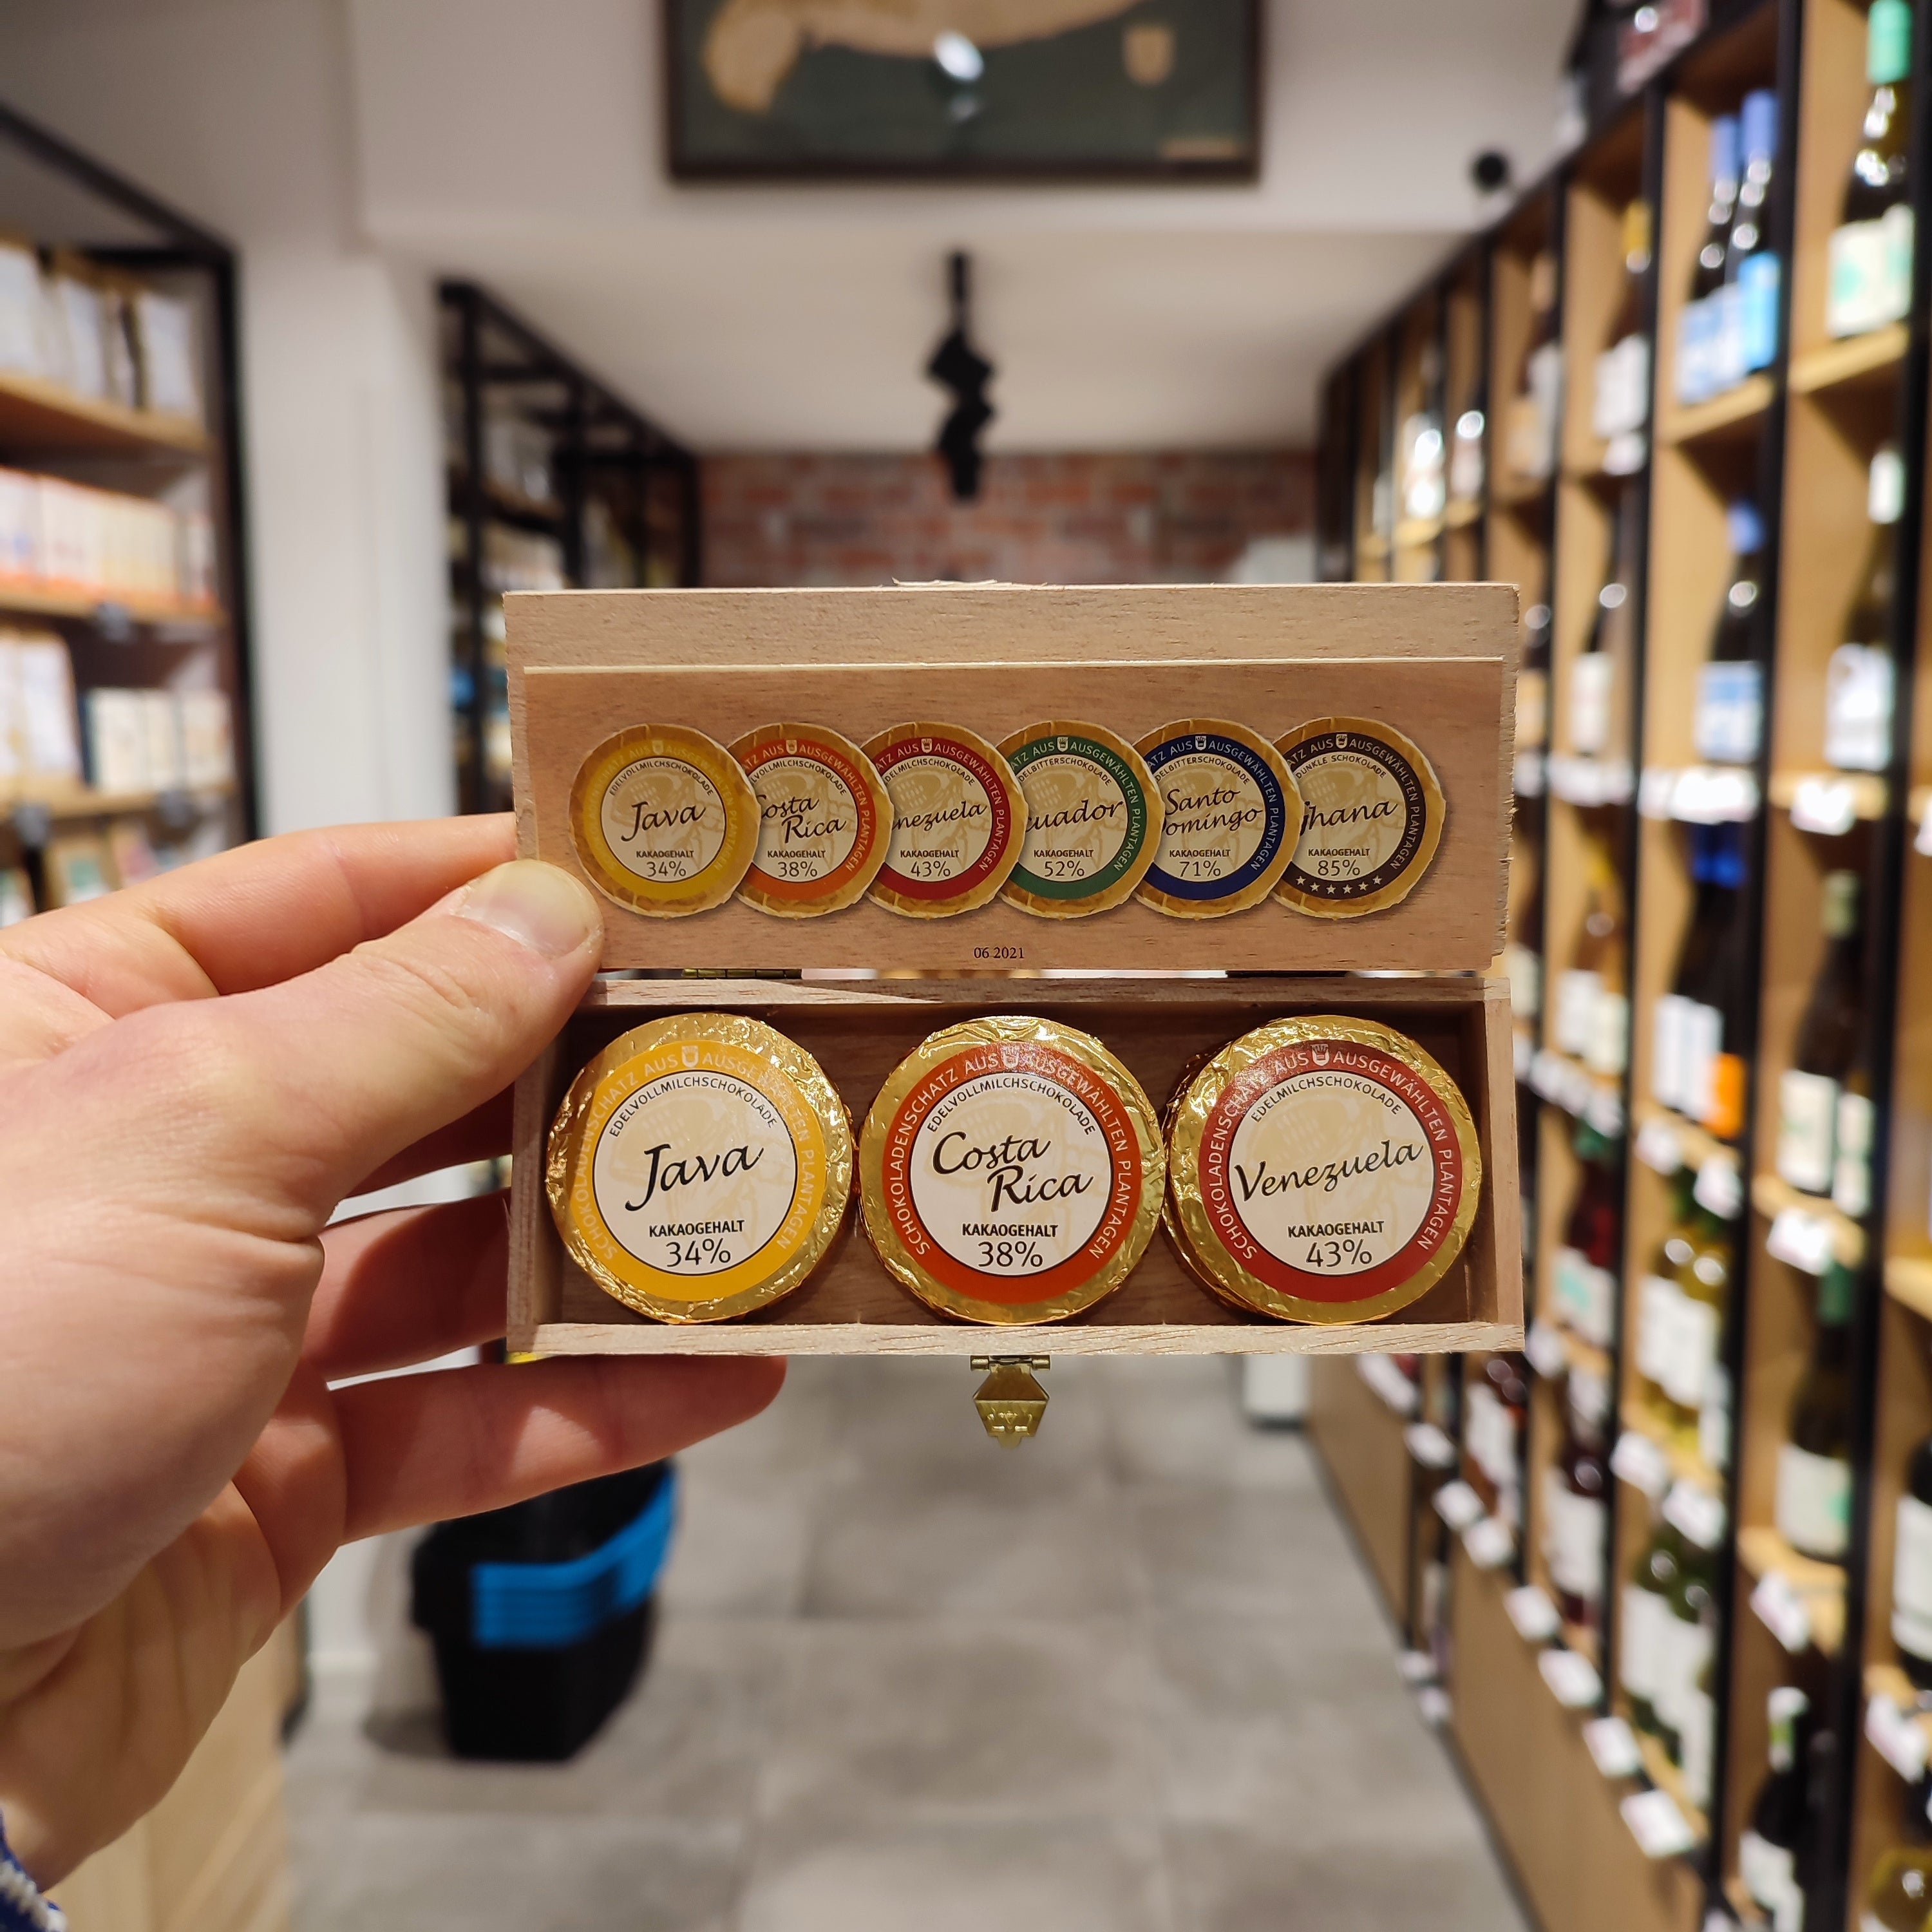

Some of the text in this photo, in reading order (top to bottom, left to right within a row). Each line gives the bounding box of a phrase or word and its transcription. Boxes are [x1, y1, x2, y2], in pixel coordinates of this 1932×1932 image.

[885, 758, 975, 786] DELMILCHSCHOKOLADE
[1155, 756, 1250, 785] DELBITTERSCHOKOLADE
[1295, 754, 1387, 779] DUNKLE SCHOKOLADE
[762, 746, 784, 759] AUS
[799, 745, 867, 805] AUSGEWÄHLTEN
[846, 810, 870, 871] PLANTAGEN
[891, 800, 987, 831] nezuela
[897, 743, 919, 758] AUS
[934, 743, 1002, 805] AUSGEWÄHLTEN
[979, 810, 1005, 871] PLANTAGEN
[1032, 741, 1055, 756] AUS
[1070, 741, 1139, 804] AUSGEWÄHLTEN
[1113, 808, 1141, 871] PLANTAGEN
[1165, 788, 1241, 816] Santo
[1170, 740, 1193, 756] AUS
[1208, 740, 1277, 803] AUSGEWÄHLTEN
[1251, 808, 1280, 870] PLANTAGEN
[1311, 739, 1334, 753] AUS
[1349, 739, 1419, 802] AUSGEWÄHLTEN
[1390, 806, 1419, 870] PLANTAGEN
[621, 801, 706, 842] Java
[781, 815, 847, 844] Rica
[636, 850, 694, 858] KAKAOGEHALT
[767, 850, 826, 858] KAKAOGEHALT
[1308, 848, 1370, 857] KAKAOGEHALT
[1318, 859, 1361, 876] 85%
[646, 861, 687, 877] 34%
[778, 861, 818, 877] 38%
[911, 861, 951, 877] 43%
[1044, 860, 1085, 877] 52%
[1179, 860, 1221, 877] 71%
[609, 1076, 778, 1139] EDELVOLLMILCHSCHOKOLADE
[927, 1077, 1096, 1135] EDELVOLLMILCHSCHOKOLADE
[1251, 1075, 1402, 1123] EDELMILCHSCHOKOLADE
[644, 1053, 678, 1076] AUS
[776, 1149, 815, 1250] PLANTAGEN
[889, 1052, 1131, 1260] SCHOKOLADENSCHATZ AUS AUSGEWÄHLTEN PLANTAGEN
[932, 1131, 1051, 1175] Costa
[1274, 1052, 1309, 1075] AUS
[1332, 1051, 1448, 1142] AUSGEWÄHLTEN
[1417, 1148, 1454, 1250] PLANTAGEN
[625, 1143, 764, 1212] Java
[1234, 1139, 1424, 1202] Venezuela
[987, 1164, 1094, 1213] Rica
[649, 1220, 744, 1237] KAKAOGEHALT
[962, 1224, 1058, 1237] KAKAOGEHALT
[1287, 1221, 1384, 1238] KAKAOGEHALT
[665, 1237, 731, 1267] 34%
[977, 1240, 1043, 1268] 38%
[1305, 1238, 1372, 1268] 43%
